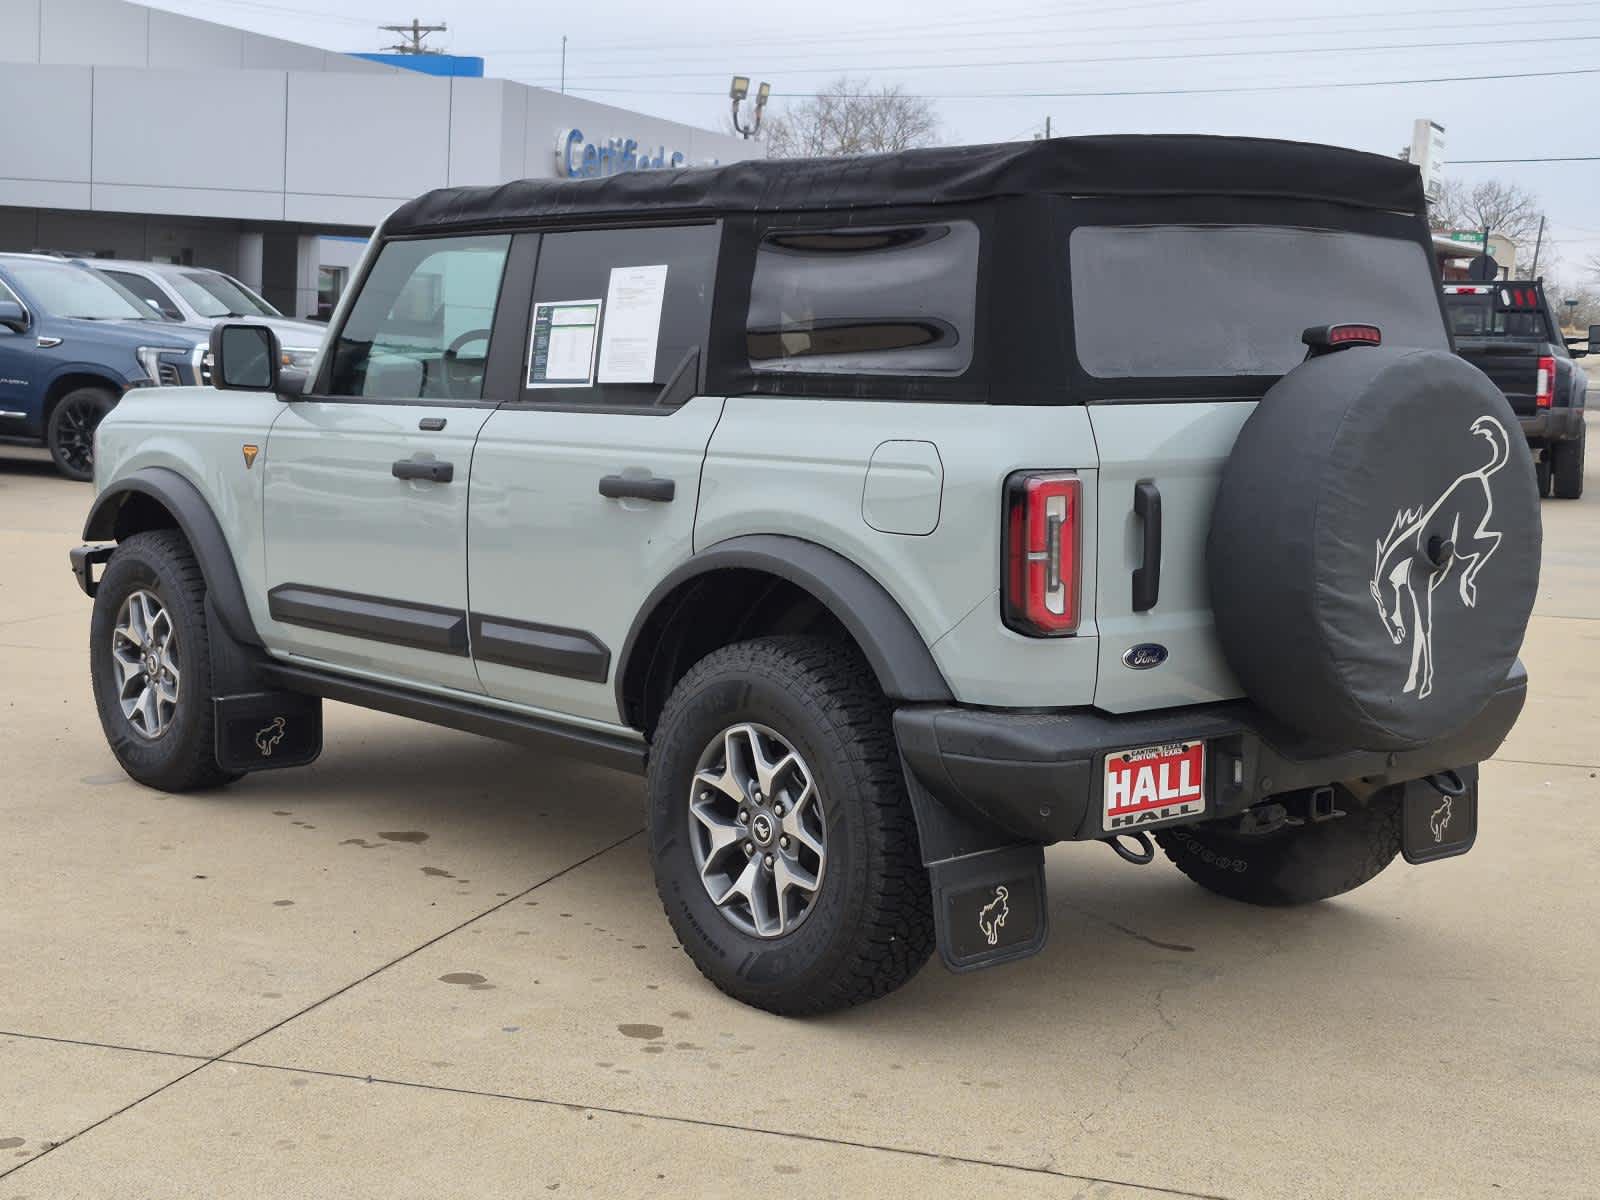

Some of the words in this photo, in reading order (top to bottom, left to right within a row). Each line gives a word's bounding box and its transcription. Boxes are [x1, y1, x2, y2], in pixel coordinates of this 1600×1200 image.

[1134, 650, 1160, 665] Ford
[1108, 759, 1200, 810] HALL
[1111, 804, 1199, 828] HALL
